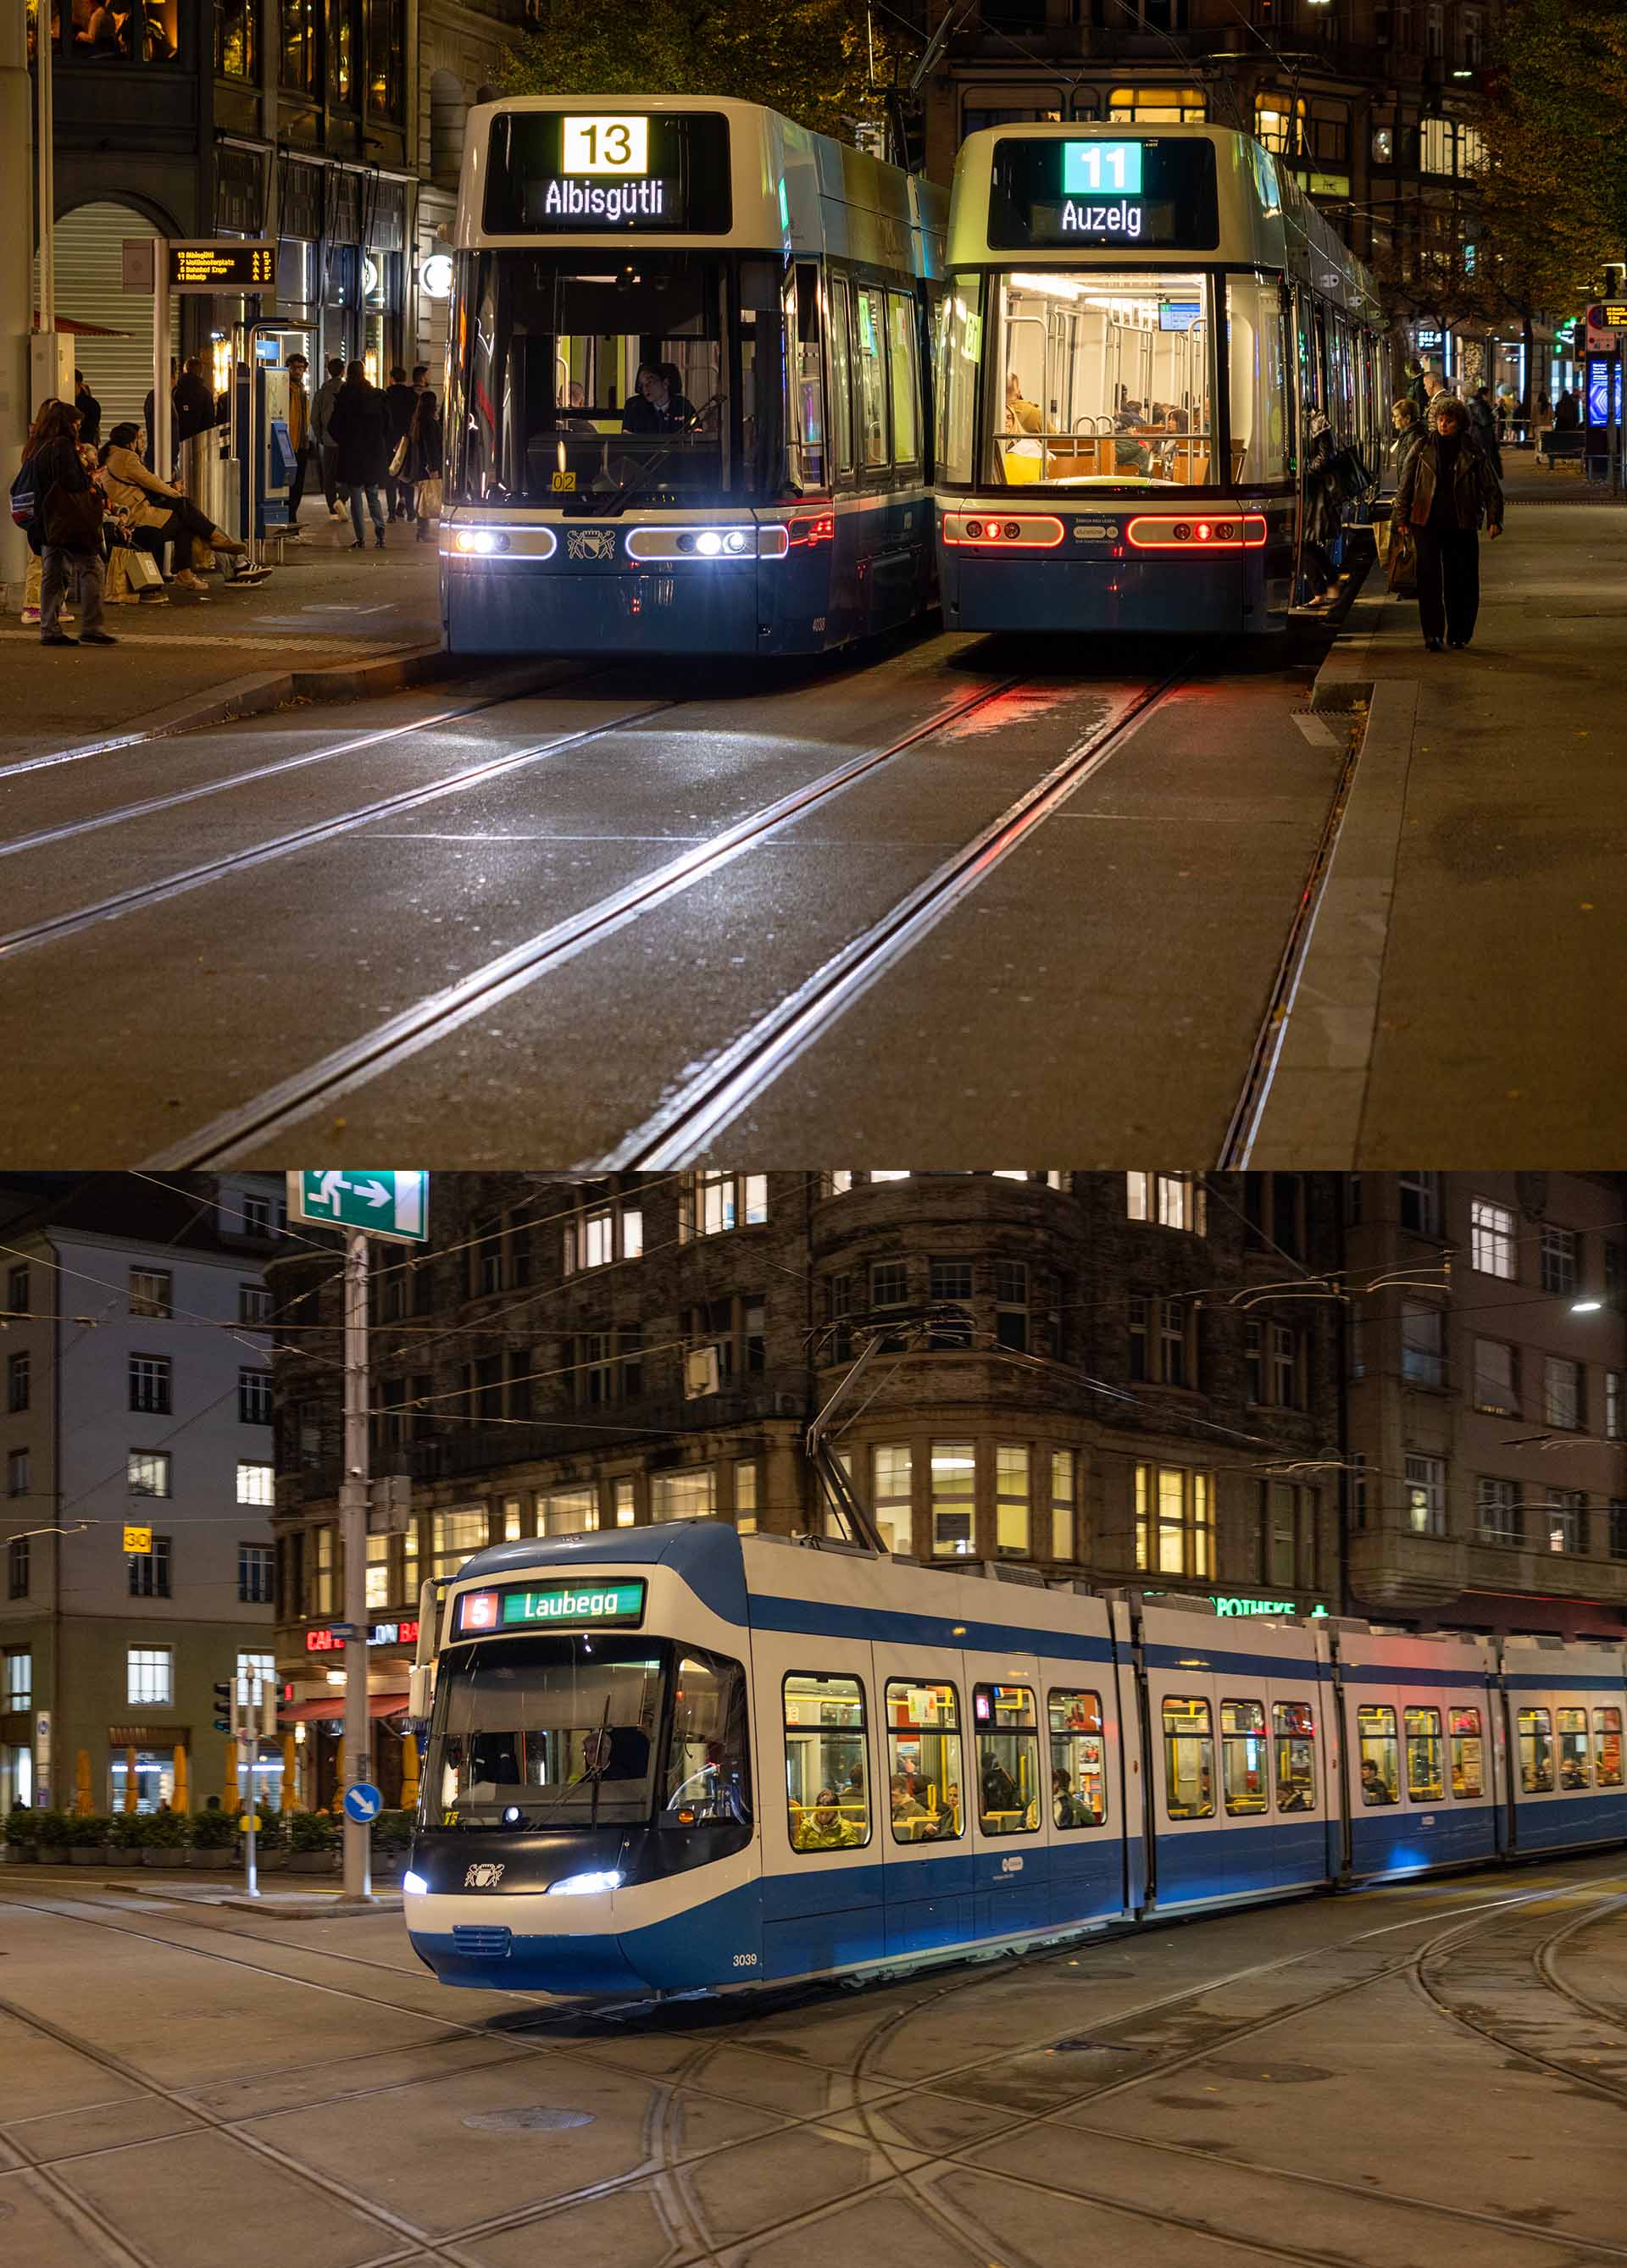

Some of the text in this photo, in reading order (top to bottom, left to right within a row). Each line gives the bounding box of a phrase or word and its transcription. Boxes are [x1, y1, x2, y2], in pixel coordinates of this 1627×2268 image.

[580, 124, 632, 165] 13
[1080, 147, 1125, 189] 11
[545, 180, 663, 221] Albisgütli
[1062, 199, 1141, 237] Auzelg
[553, 475, 574, 490] 02
[125, 1533, 151, 1547] 30
[471, 1591, 618, 1625] 5 Laubegg
[733, 1953, 758, 1966] 3039
